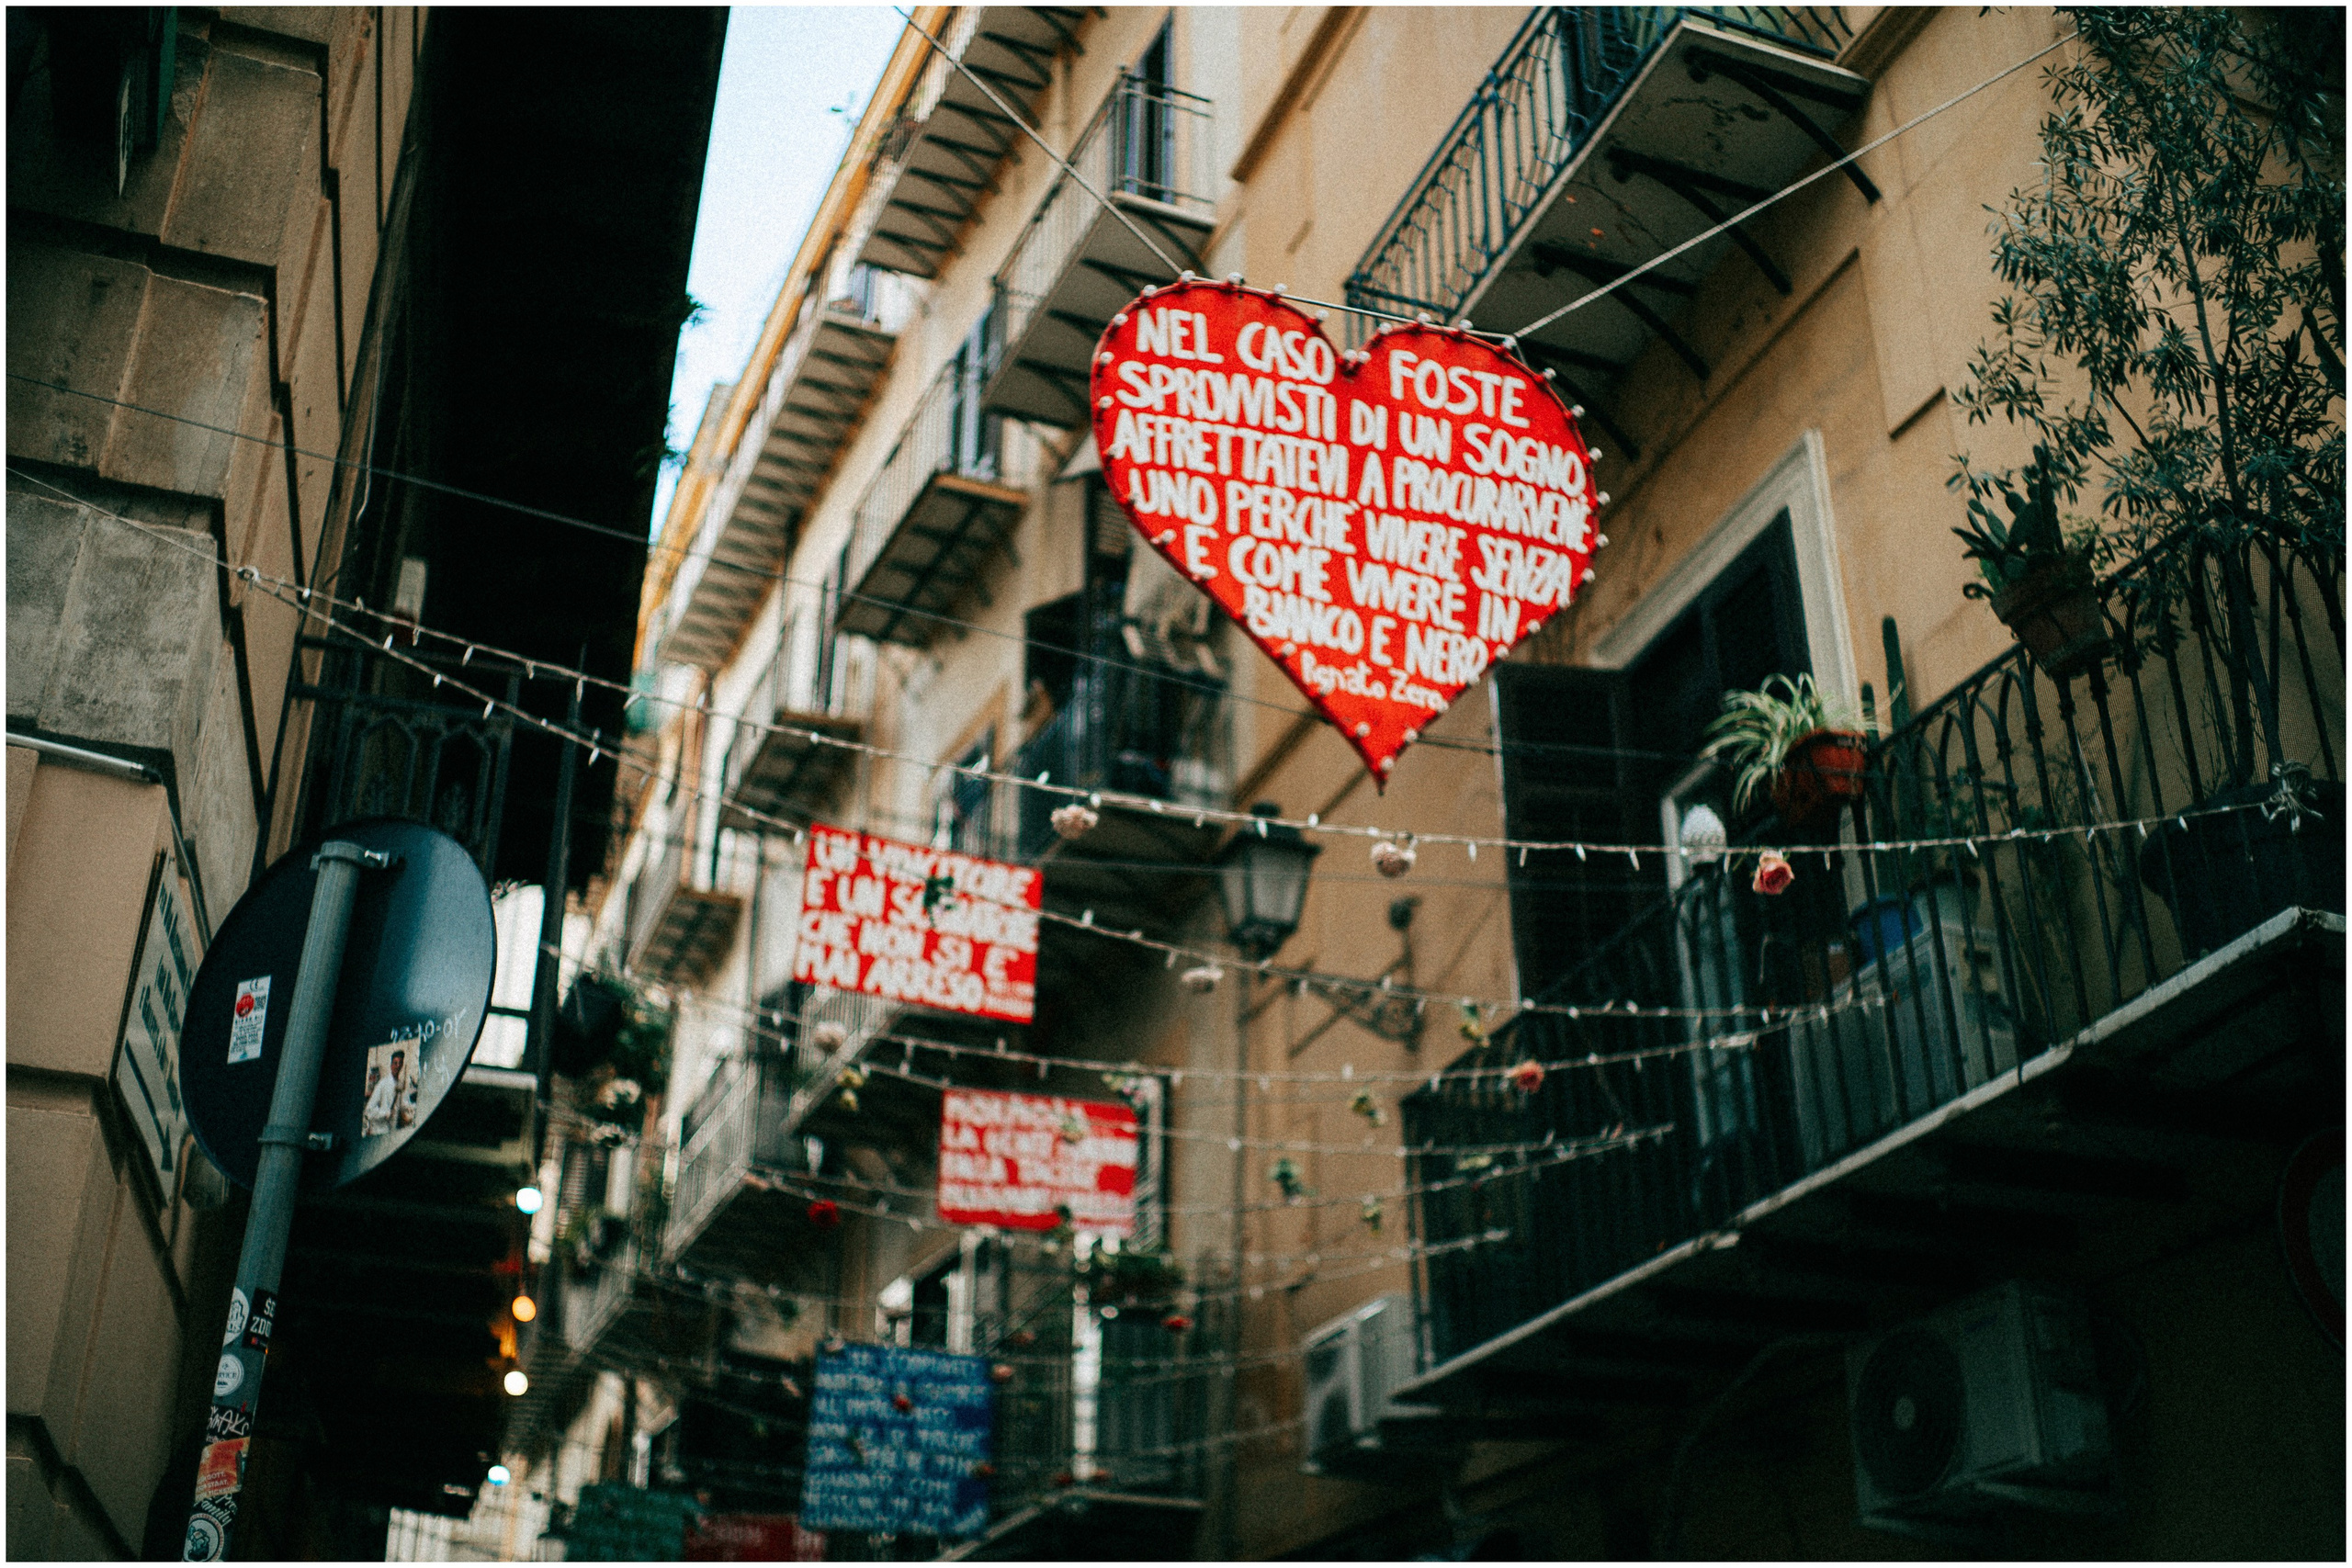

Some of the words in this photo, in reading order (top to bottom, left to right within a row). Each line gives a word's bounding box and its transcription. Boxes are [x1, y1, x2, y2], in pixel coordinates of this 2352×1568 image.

[1136, 307, 1225, 364] NEL
[1236, 321, 1336, 385] CASO
[1388, 348, 1530, 428] FOSTE
[1111, 408, 1350, 498] AFFRETTATEVI
[1357, 451, 1387, 510] A
[1392, 456, 1592, 554] PROCURARVENE
[1350, 398, 1388, 451] DI
[1398, 411, 1452, 464] UN
[1462, 422, 1587, 497] SOGNO
[1128, 468, 1219, 526] UNO
[1363, 509, 1467, 582] VIVERE
[1470, 533, 1572, 607] SENZA
[1227, 535, 1333, 603] COME
[1345, 556, 1467, 632] VIVERE
[1476, 591, 1521, 645] IN
[1243, 584, 1364, 655] BIANCO
[1370, 615, 1397, 666] E
[1404, 622, 1489, 686] NERO
